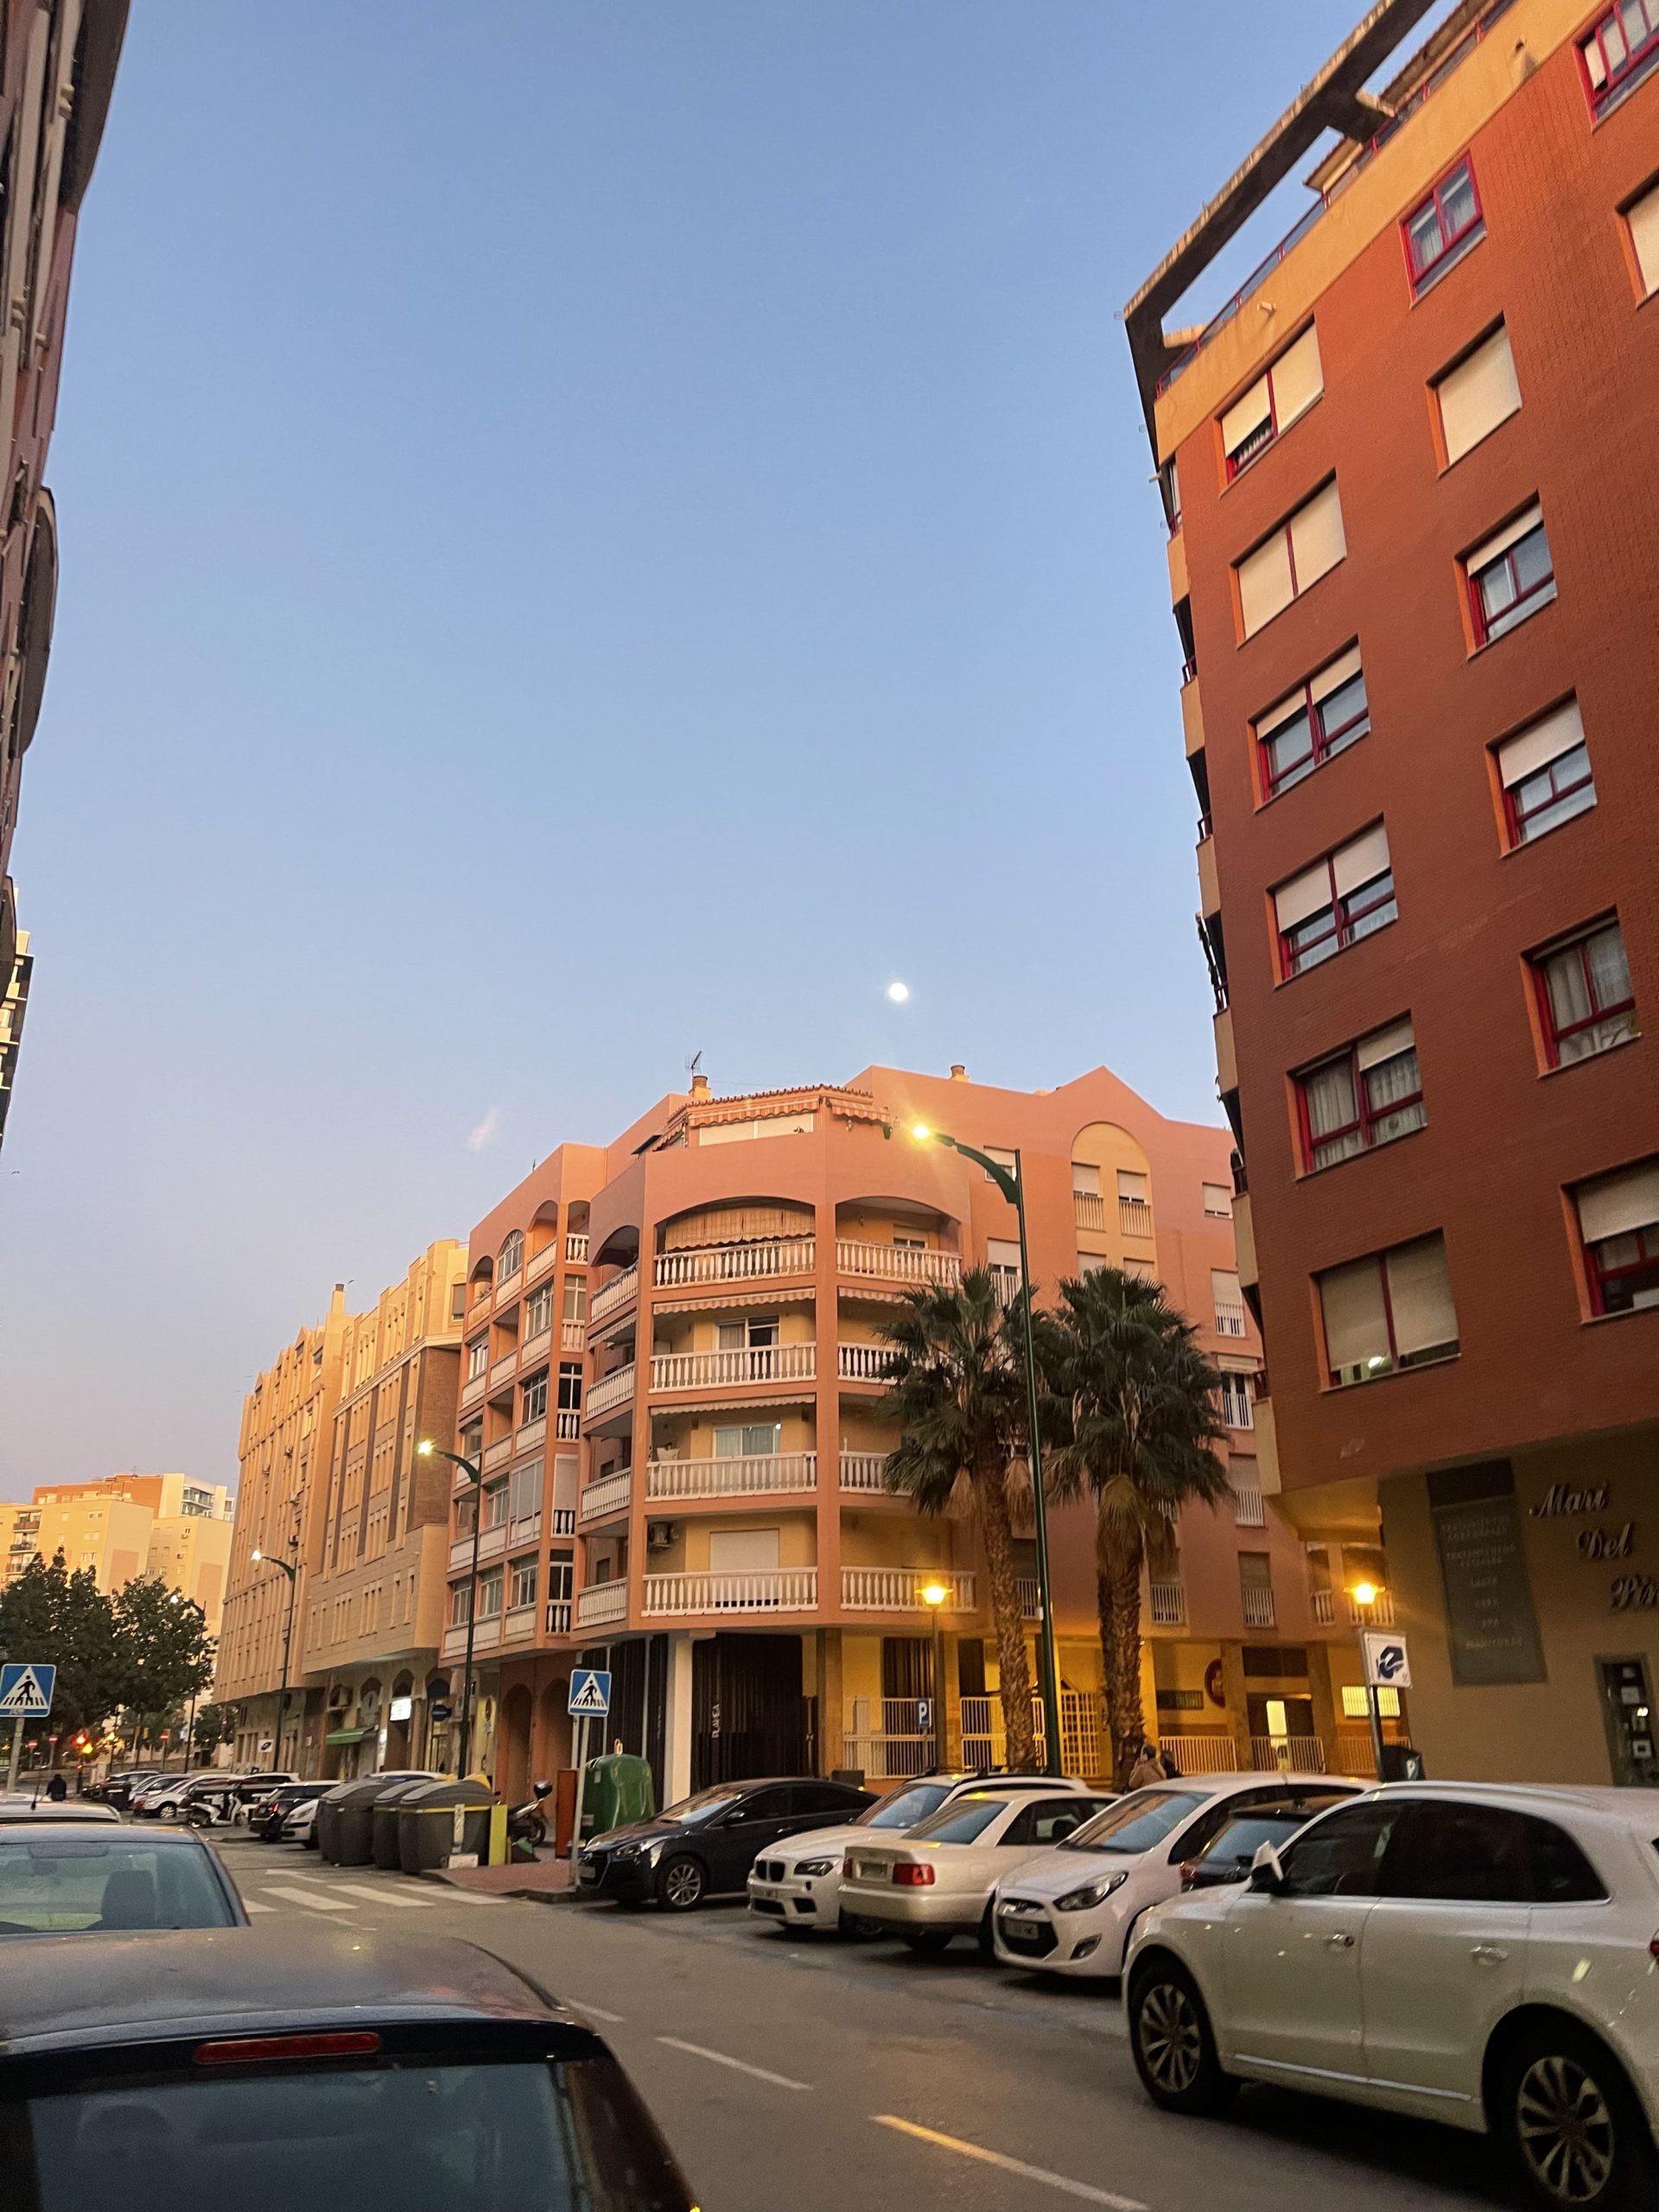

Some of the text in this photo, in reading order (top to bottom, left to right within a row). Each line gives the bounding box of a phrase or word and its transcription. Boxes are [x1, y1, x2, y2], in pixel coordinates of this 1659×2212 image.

[1529, 1479, 1610, 1518] Mari
[1575, 1522, 1633, 1559] Del
[918, 1701, 927, 1725] P
